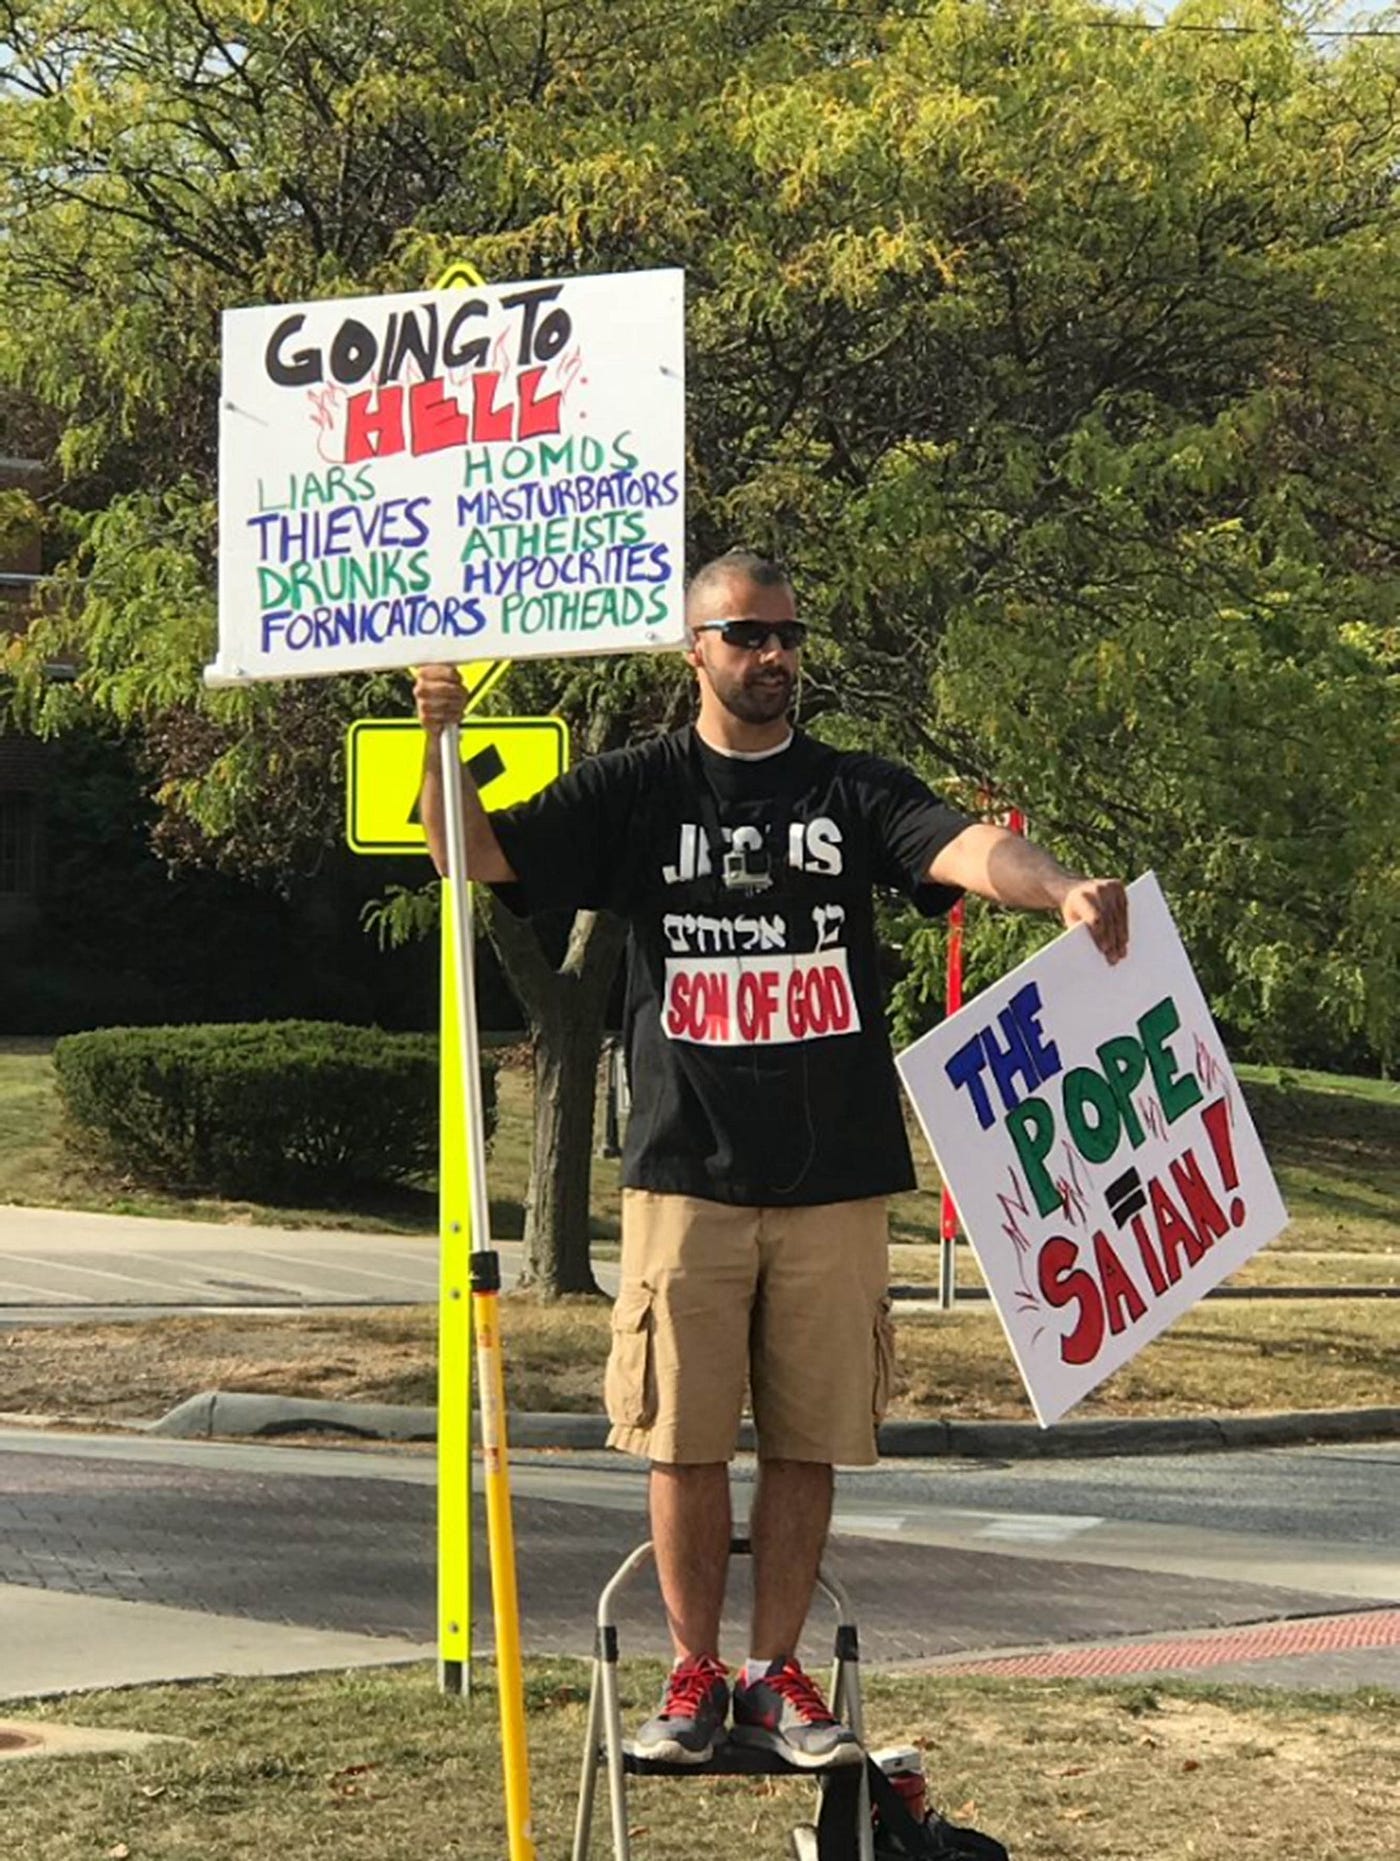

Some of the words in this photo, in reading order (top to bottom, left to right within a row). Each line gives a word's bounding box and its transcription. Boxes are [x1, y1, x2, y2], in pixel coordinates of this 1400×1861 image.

[265, 300, 490, 387] GOING
[258, 465, 375, 511] LIARS
[464, 431, 639, 487] HOMOS
[457, 471, 679, 526] MASTURBATORS
[247, 497, 430, 563] THIEVES
[460, 510, 647, 562] ATHEISTS
[258, 550, 432, 610] DRUNKS
[463, 543, 672, 595] HYPOCRITES
[261, 594, 486, 653] FORNICATORS
[501, 584, 668, 634] POTHEADS
[667, 971, 730, 1040] SON
[736, 971, 779, 1041] OF
[787, 965, 851, 1038] GOD
[944, 980, 1063, 1130] THE
[1005, 996, 1204, 1219] POPE
[1037, 1096, 1246, 1366] SATAN!
